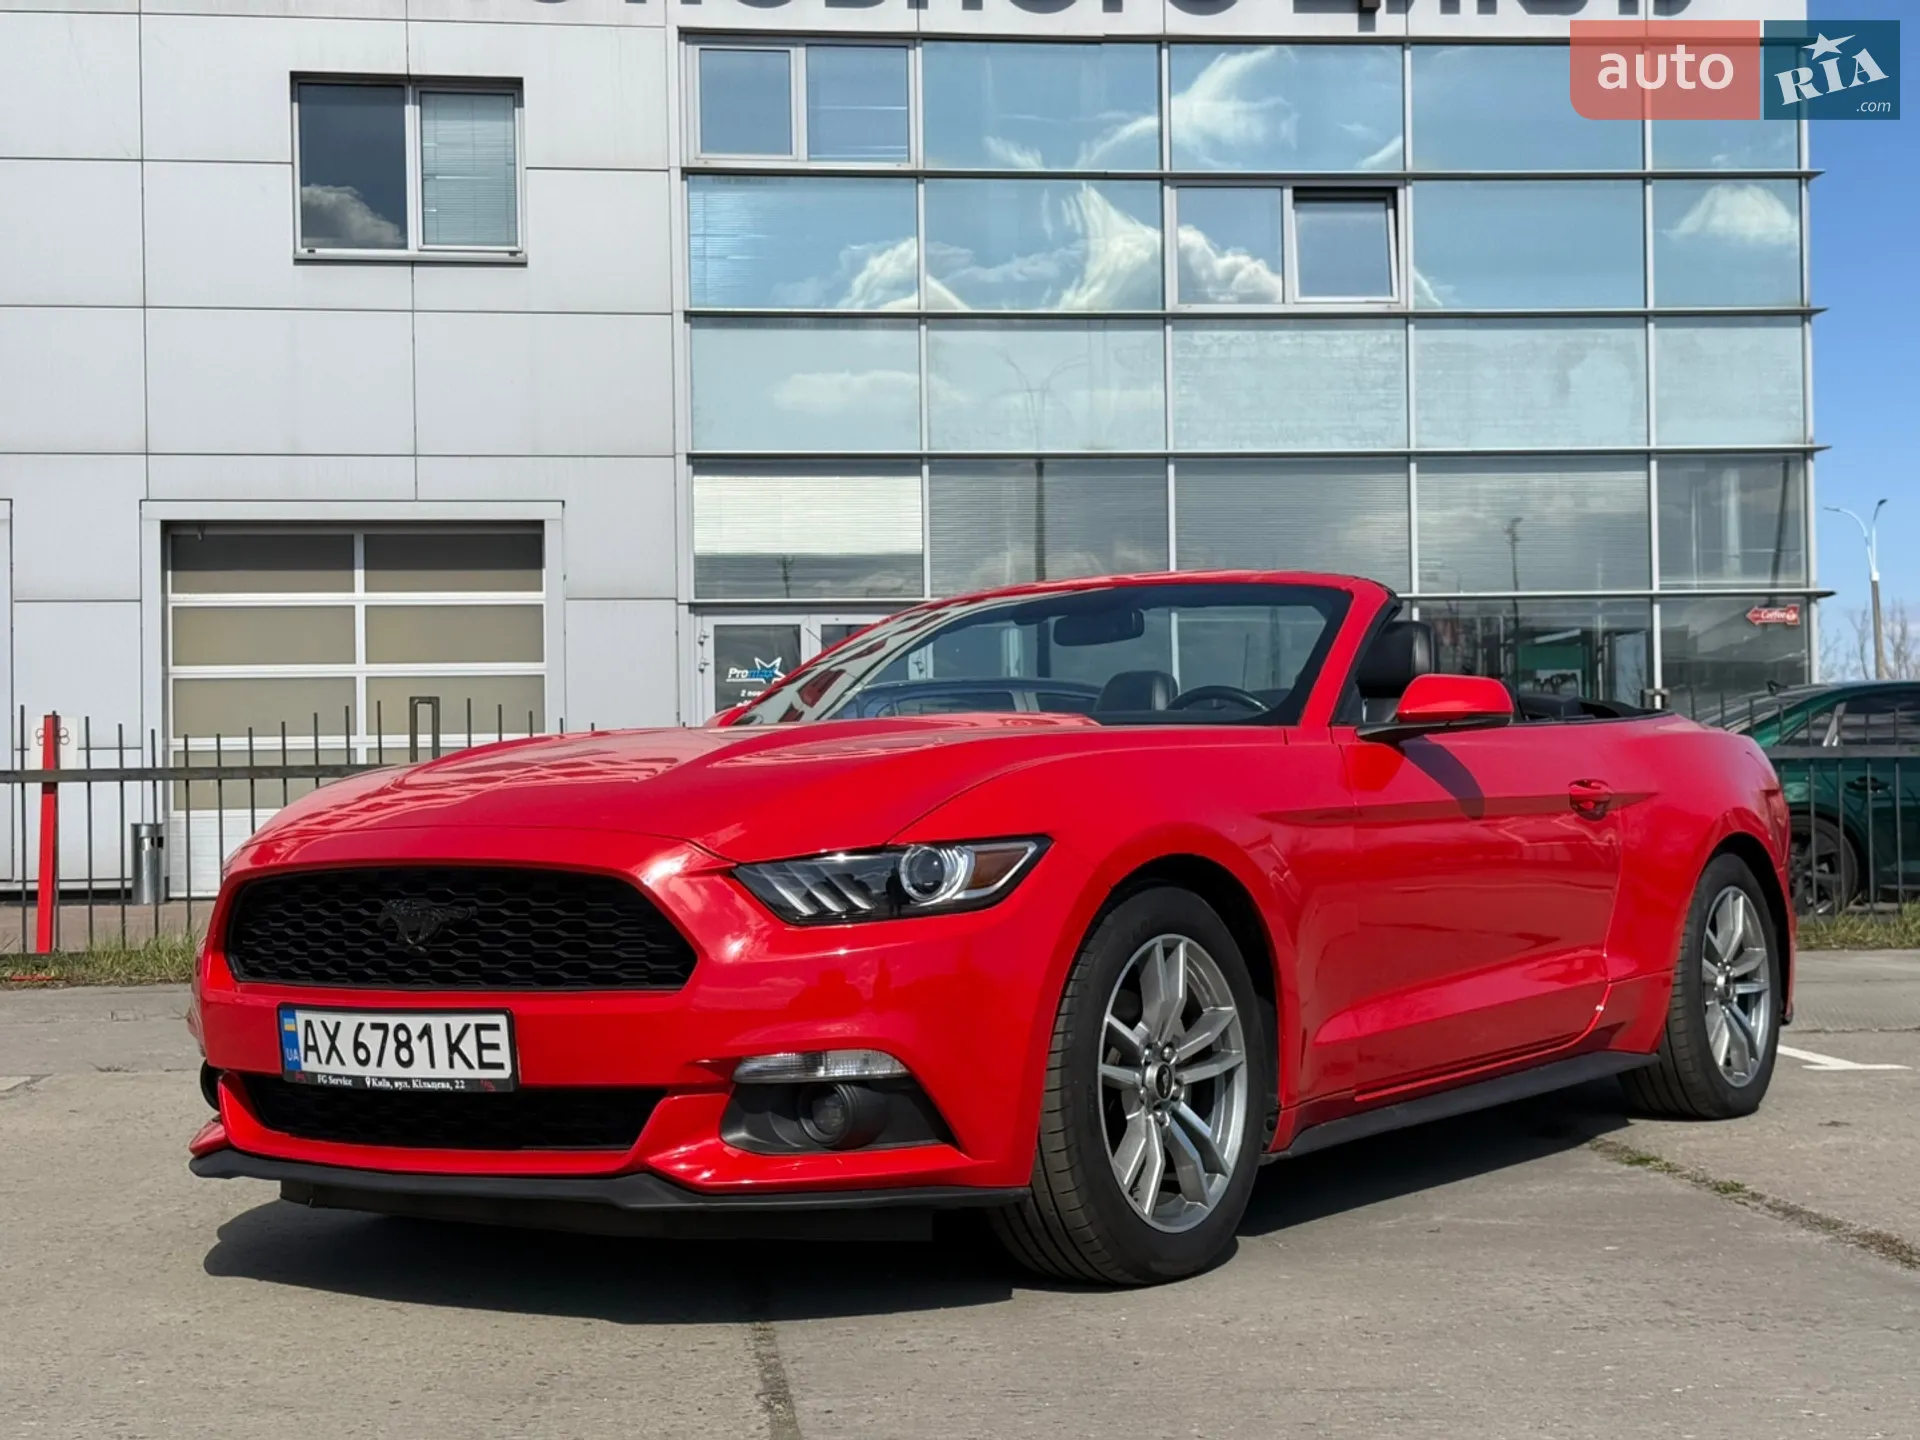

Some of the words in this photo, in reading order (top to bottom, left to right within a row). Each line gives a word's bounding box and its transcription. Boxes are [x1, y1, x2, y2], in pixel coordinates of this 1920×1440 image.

[303, 1019, 346, 1067] AX
[353, 1022, 436, 1069] 6781
[445, 1022, 505, 1070] KE
[286, 1048, 300, 1062] UA
[328, 1075, 353, 1087] Service
[454, 1080, 466, 1090] 22
